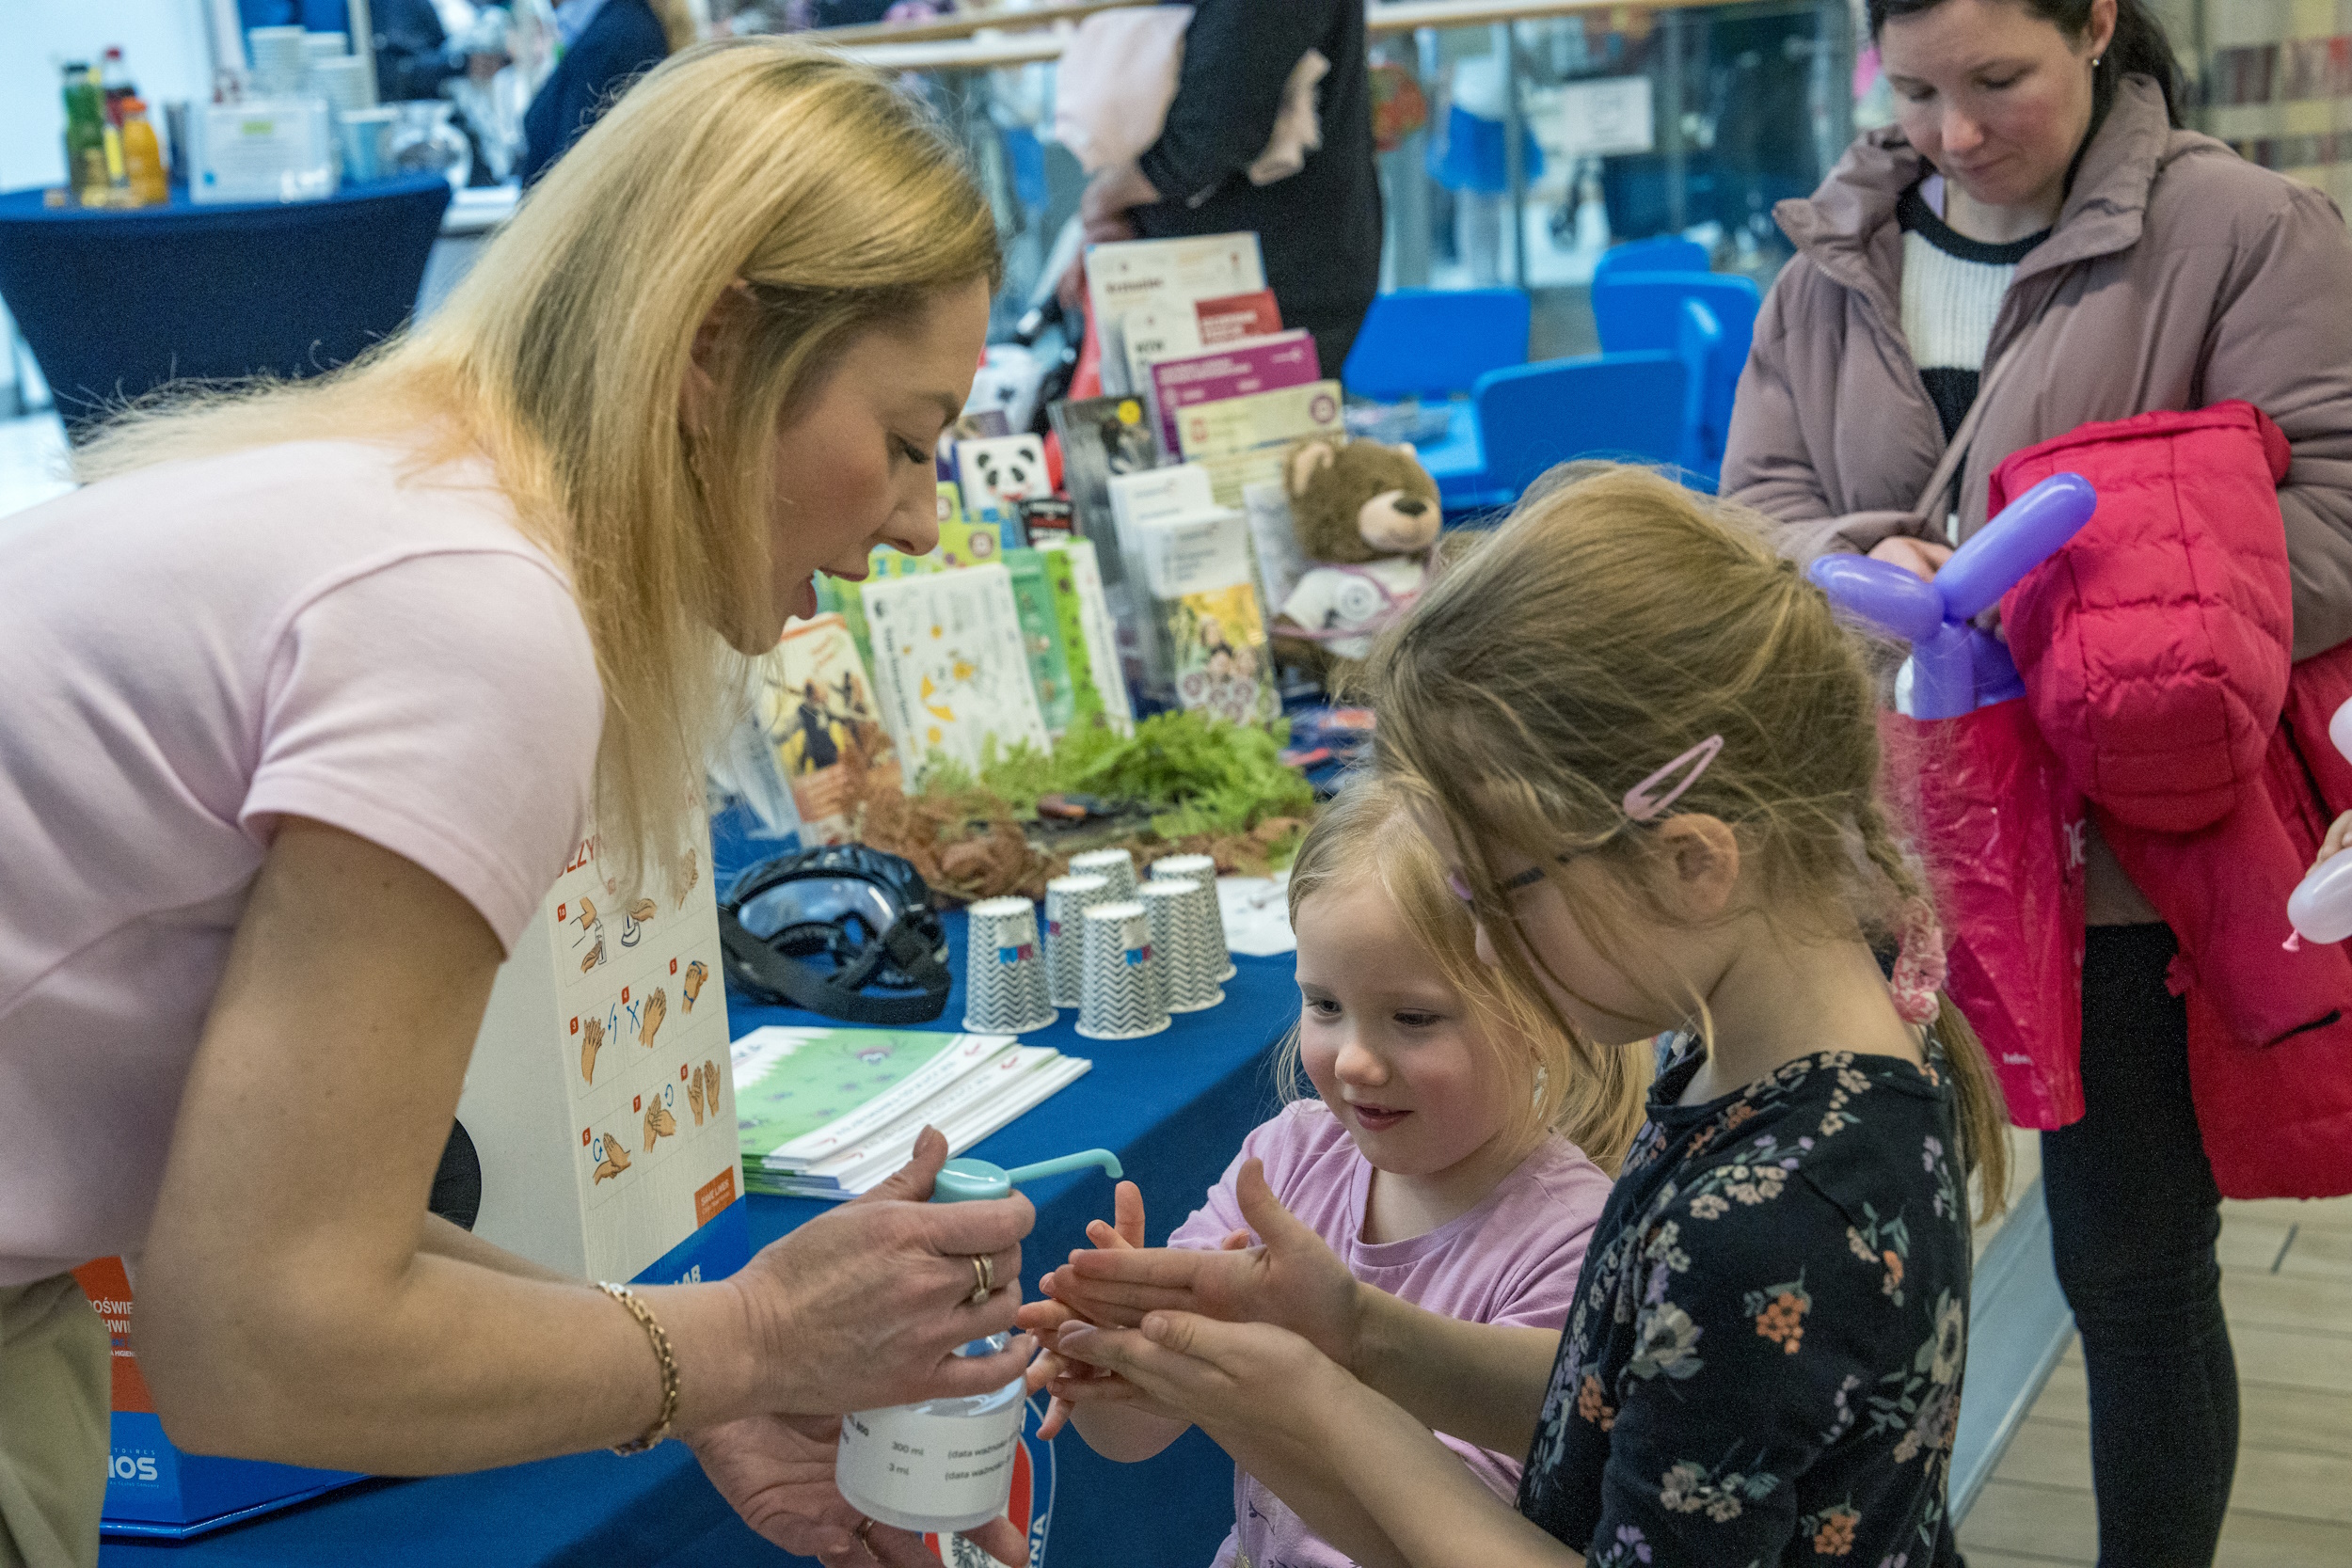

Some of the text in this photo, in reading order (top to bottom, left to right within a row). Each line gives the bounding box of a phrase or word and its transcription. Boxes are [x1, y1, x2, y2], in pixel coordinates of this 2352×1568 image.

[891, 1441, 924, 1457] 300 ml
[947, 1449, 973, 1460] (data
[889, 1462, 909, 1477] 3 ml
[945, 1470, 970, 1481] (data
